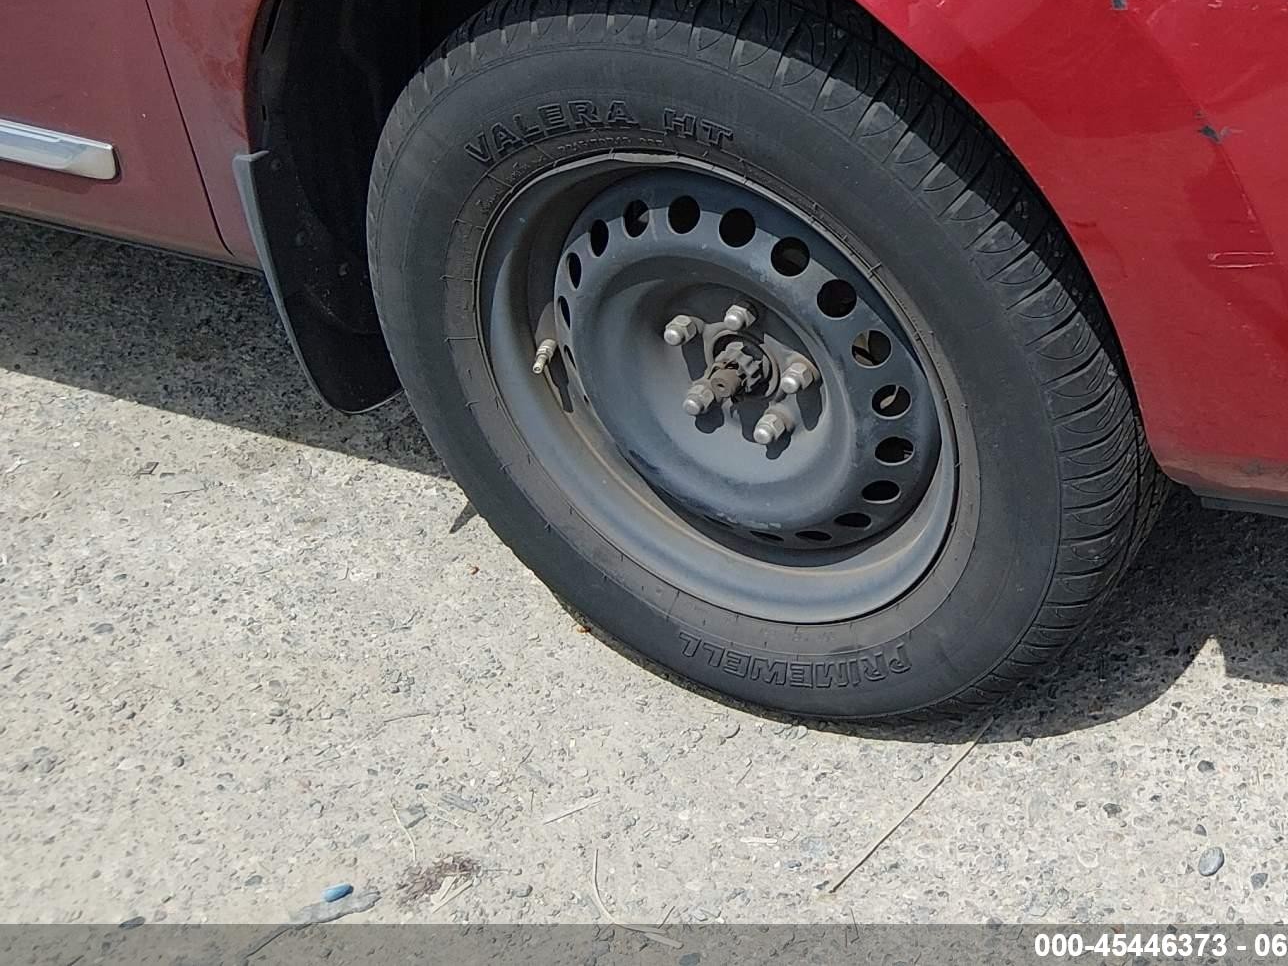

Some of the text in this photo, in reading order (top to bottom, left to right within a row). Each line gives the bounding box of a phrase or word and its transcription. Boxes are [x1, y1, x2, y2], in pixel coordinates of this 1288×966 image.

[464, 100, 734, 164] VALERA HT
[679, 630, 914, 689] PRIMEWELL
